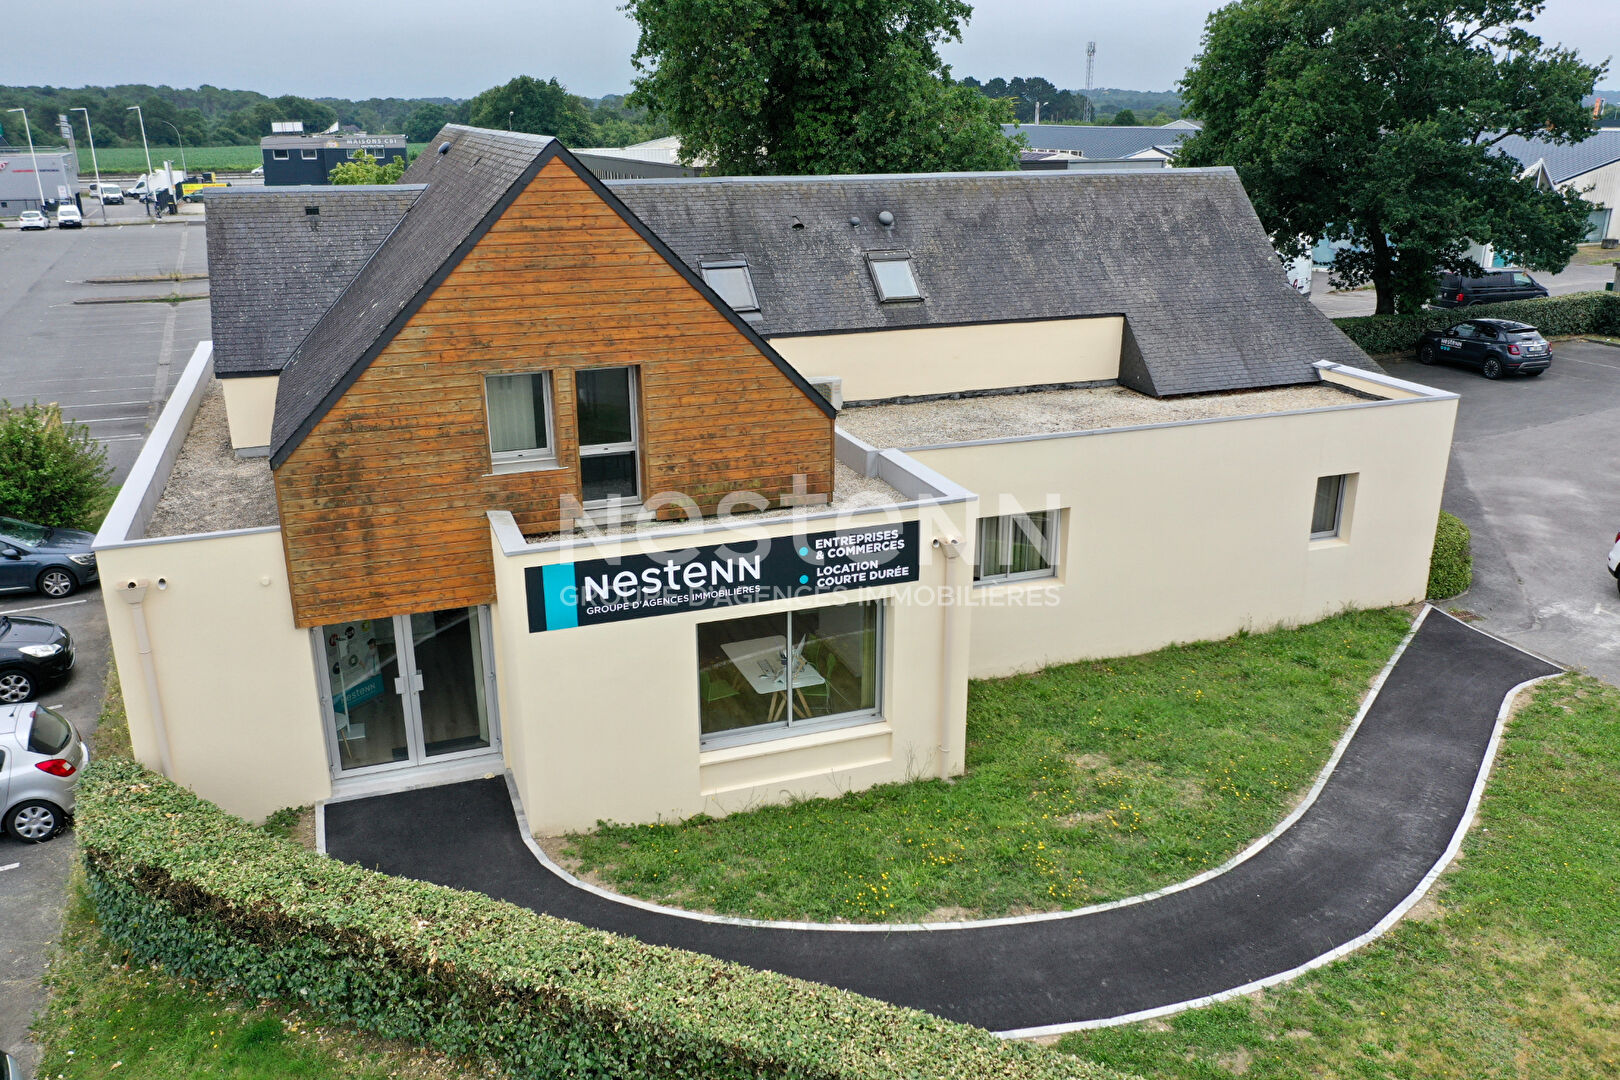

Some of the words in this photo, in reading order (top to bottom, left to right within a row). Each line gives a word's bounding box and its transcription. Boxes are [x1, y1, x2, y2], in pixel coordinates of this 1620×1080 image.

[815, 529, 899, 549] ENTREPRISES
[815, 550, 824, 560] &
[827, 539, 905, 558] COMMERCES
[816, 560, 879, 577] LOCATION
[816, 573, 866, 587] COURTE
[869, 565, 910, 580] DURÉE
[586, 602, 630, 615] GROUPE
[632, 594, 690, 609] D'AGENCES
[692, 584, 761, 601] IMMOBILIÈRES
